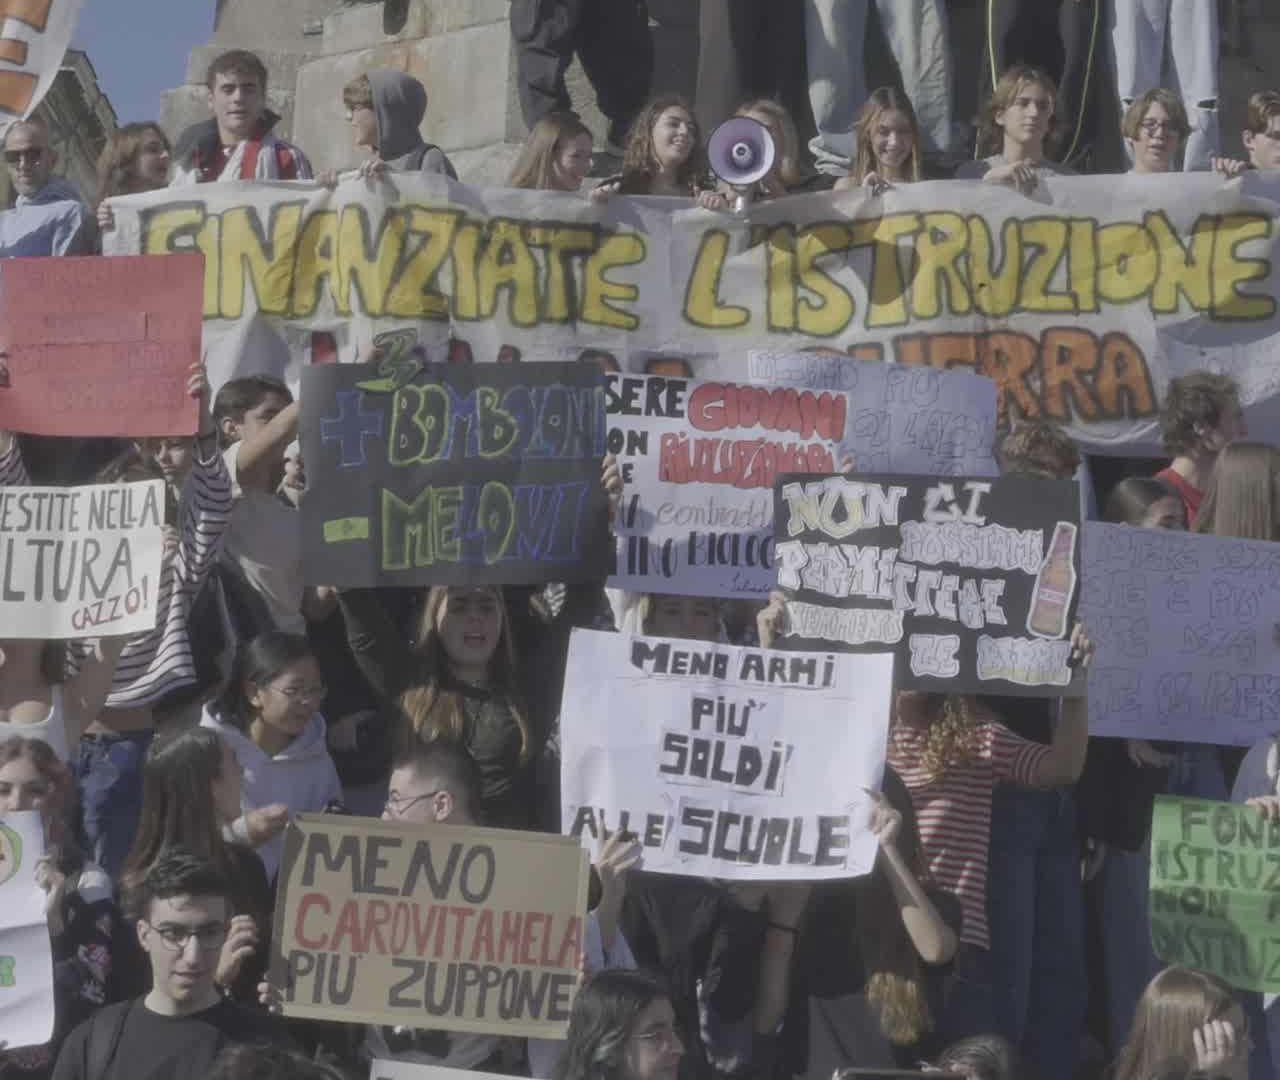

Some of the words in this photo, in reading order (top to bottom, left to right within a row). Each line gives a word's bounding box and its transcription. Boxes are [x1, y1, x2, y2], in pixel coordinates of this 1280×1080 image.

[87, 485, 161, 531] NELLA
[381, 480, 593, 571] MELONI
[782, 476, 907, 539] NON
[71, 575, 149, 632] CAZZO!
[632, 641, 729, 679] MENO
[301, 832, 497, 905] MENO
[679, 807, 851, 868] SCUOLE
[388, 957, 579, 1022] ZUPPONE
